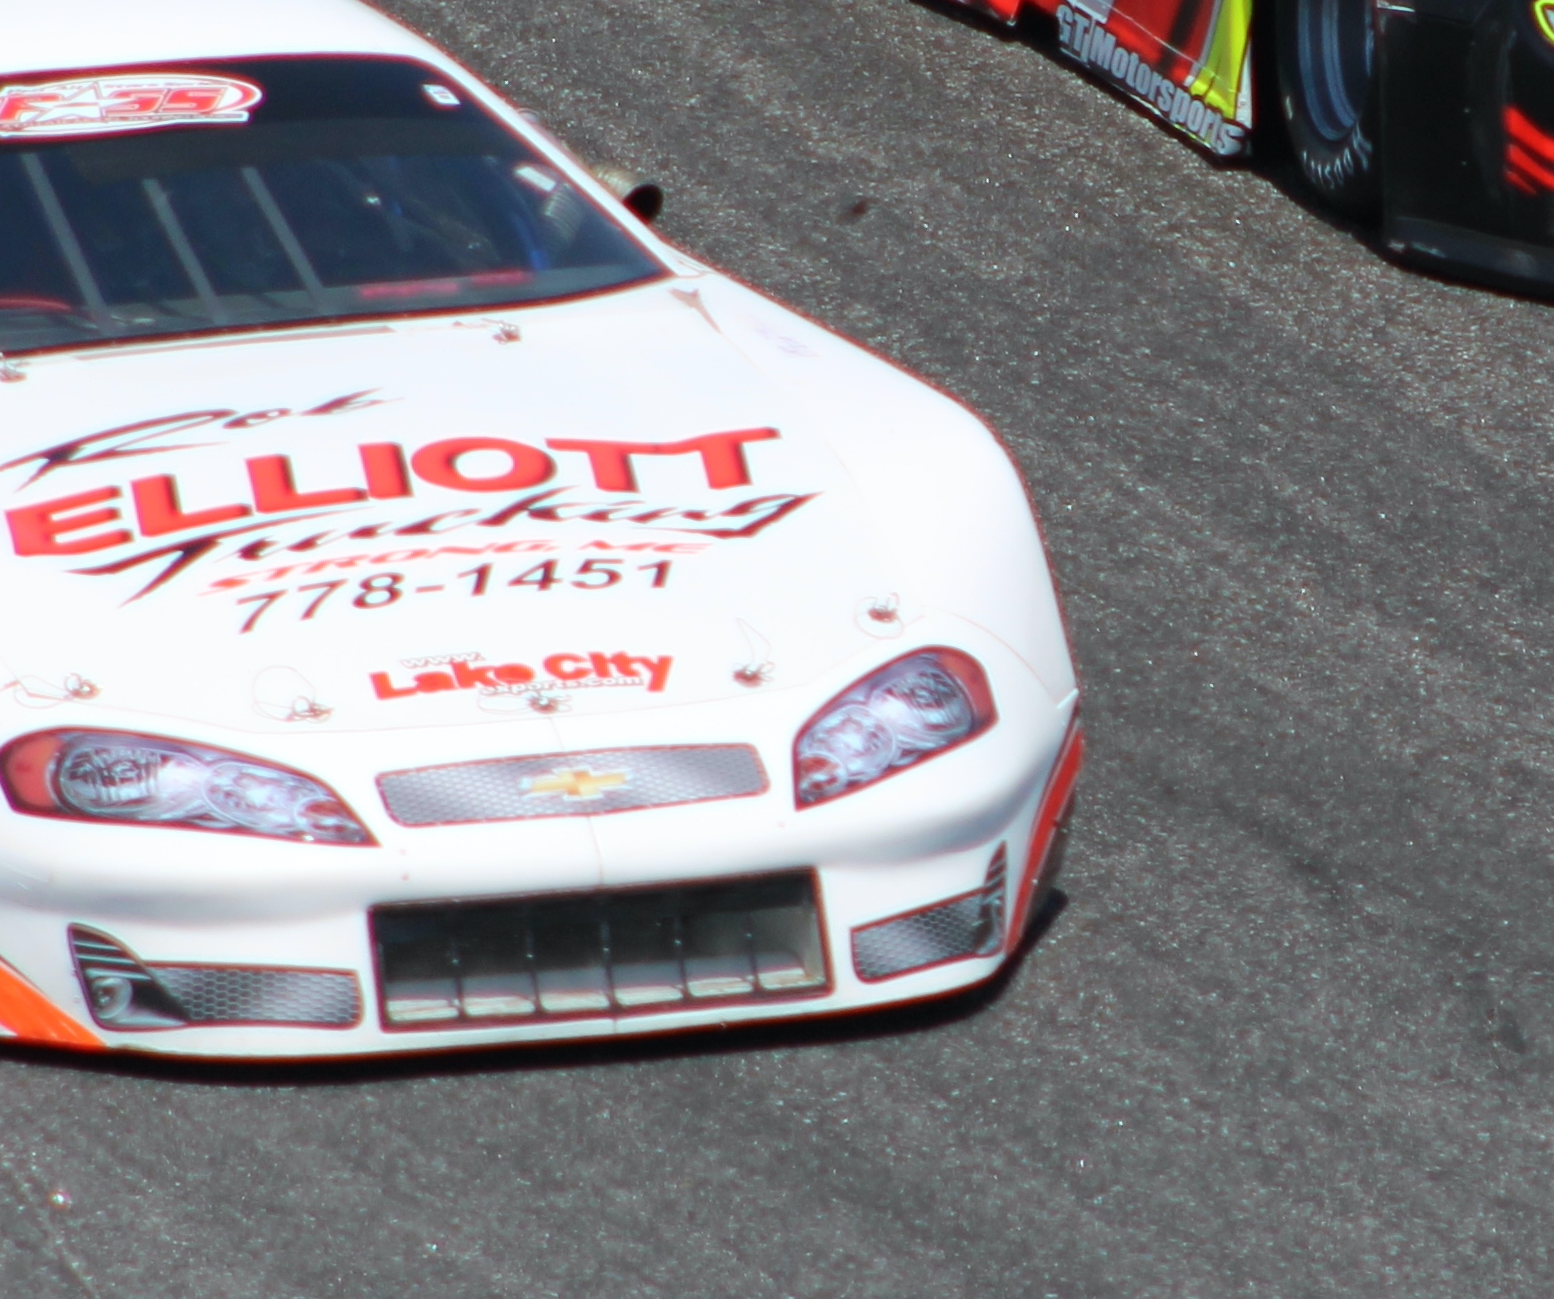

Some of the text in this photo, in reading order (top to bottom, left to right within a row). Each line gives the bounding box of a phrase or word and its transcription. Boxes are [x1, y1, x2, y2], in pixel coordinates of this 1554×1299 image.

[3, 426, 782, 558] ELLIOTT
[62, 484, 825, 609] Trucking
[236, 558, 674, 635] 778-1451
[369, 650, 674, 701] Lake City
